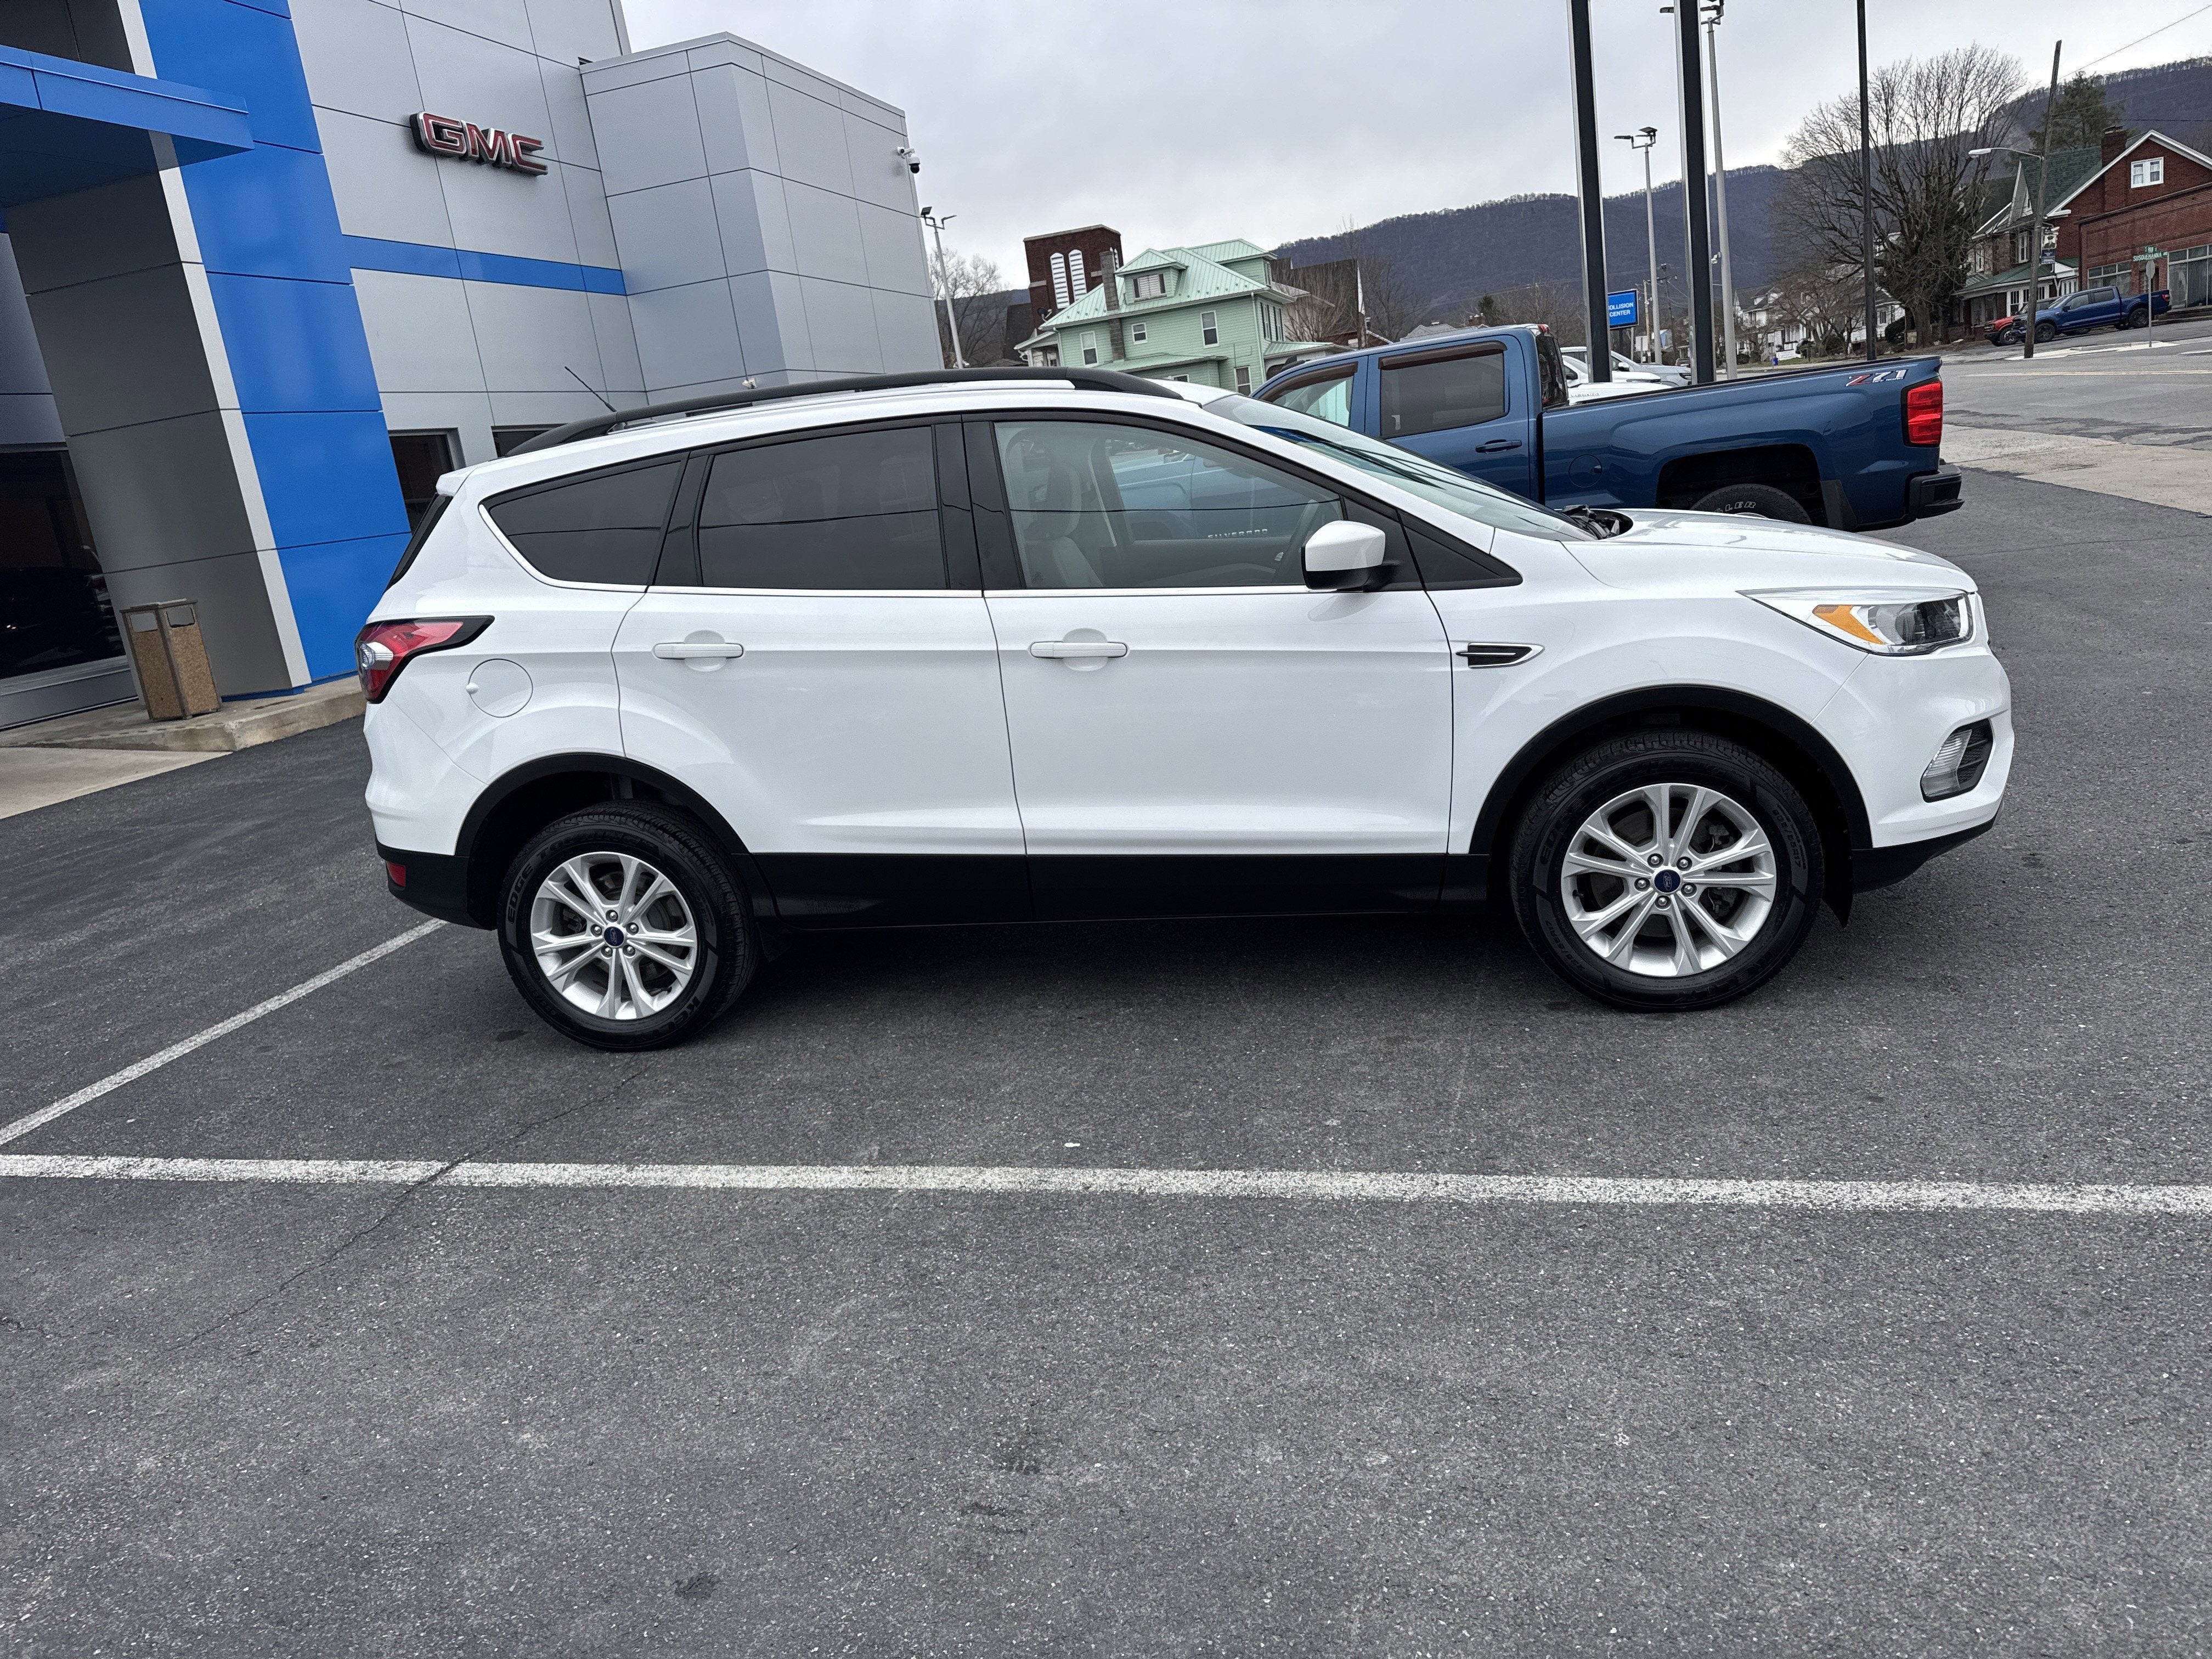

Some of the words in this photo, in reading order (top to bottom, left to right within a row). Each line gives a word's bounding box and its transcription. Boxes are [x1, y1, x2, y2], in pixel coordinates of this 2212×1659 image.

[410, 111, 549, 176] GMC
[1844, 369, 1909, 387] Z71
[507, 862, 534, 924] EDGE
